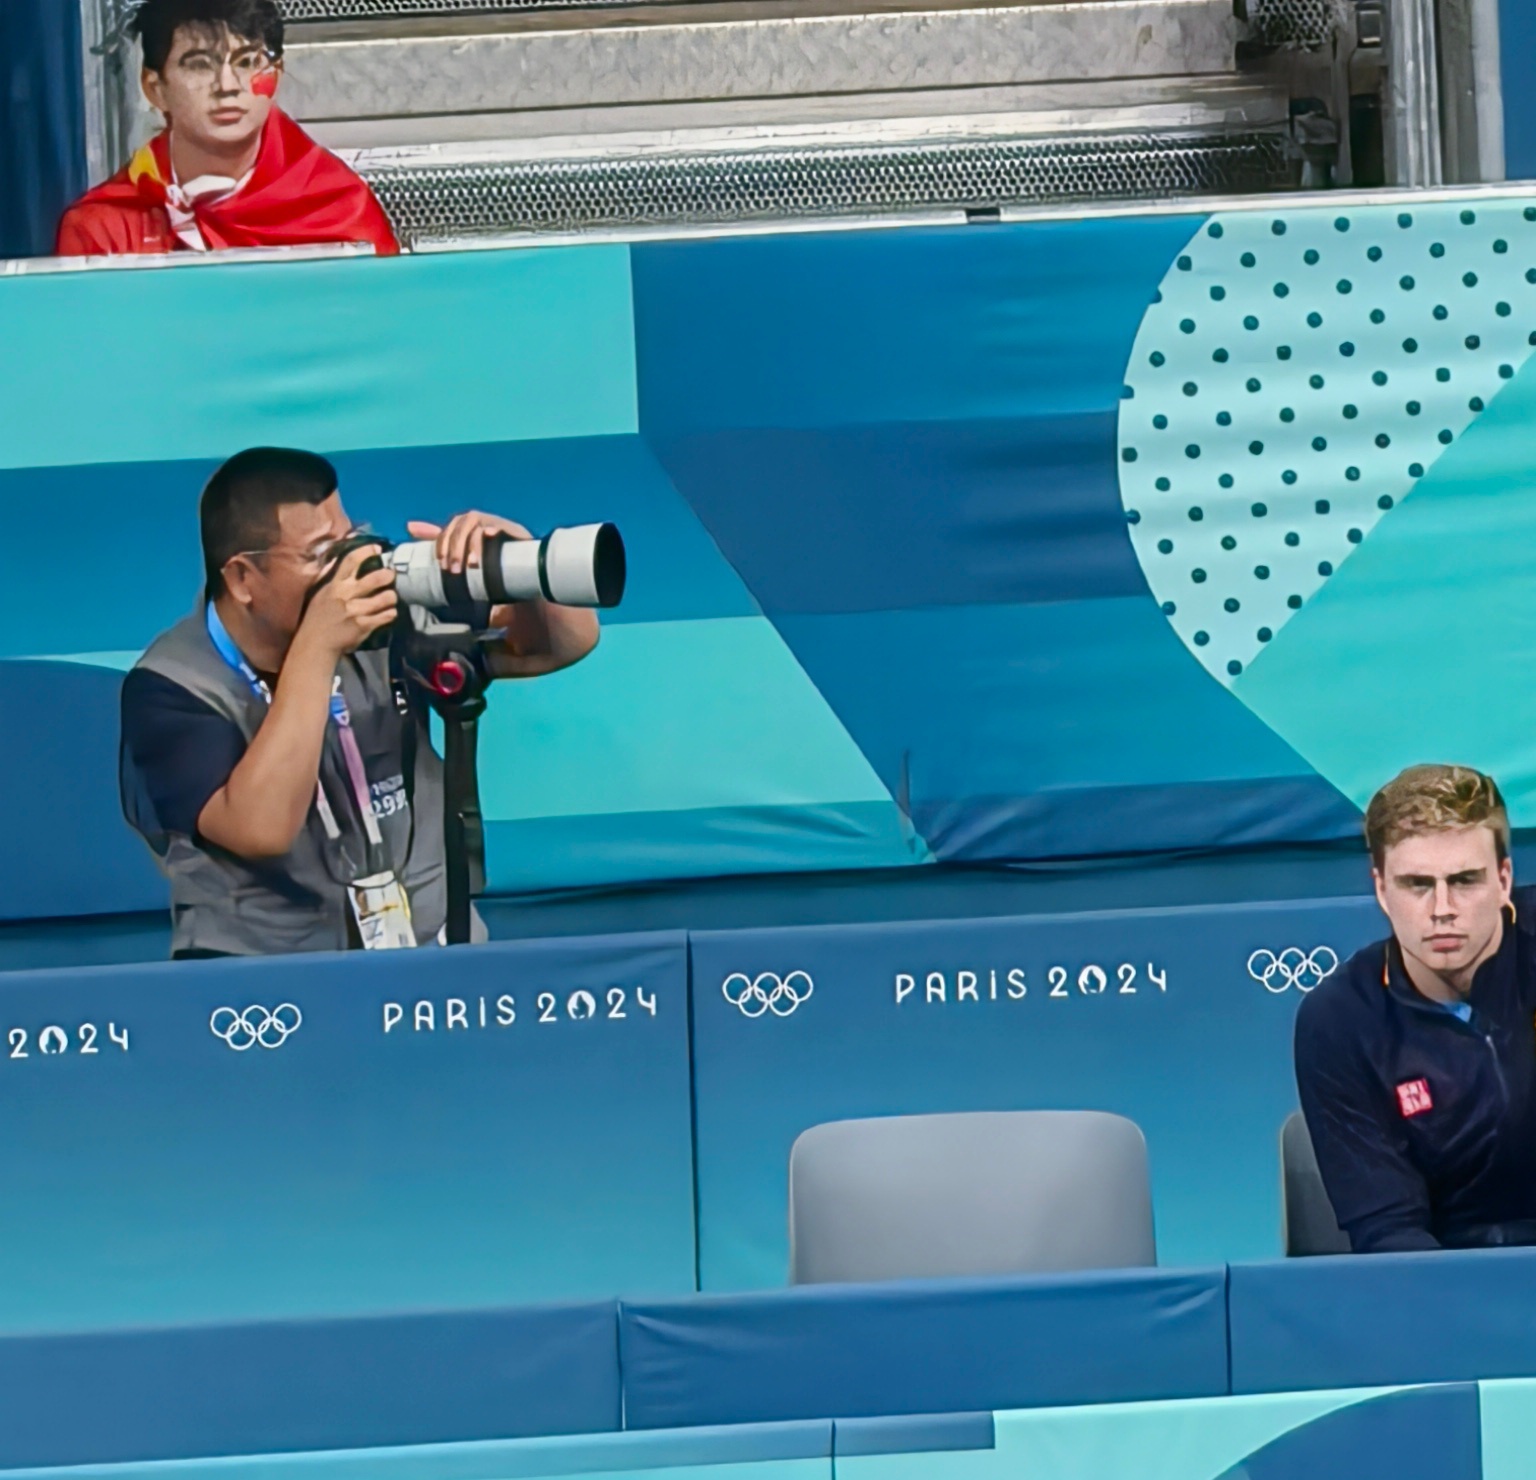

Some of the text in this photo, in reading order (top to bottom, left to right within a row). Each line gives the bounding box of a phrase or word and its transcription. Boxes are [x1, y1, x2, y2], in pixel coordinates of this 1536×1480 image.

[1048, 962, 1167, 997] 2024
[537, 987, 656, 1023] 2024
[8, 1022, 129, 1058] 2024
